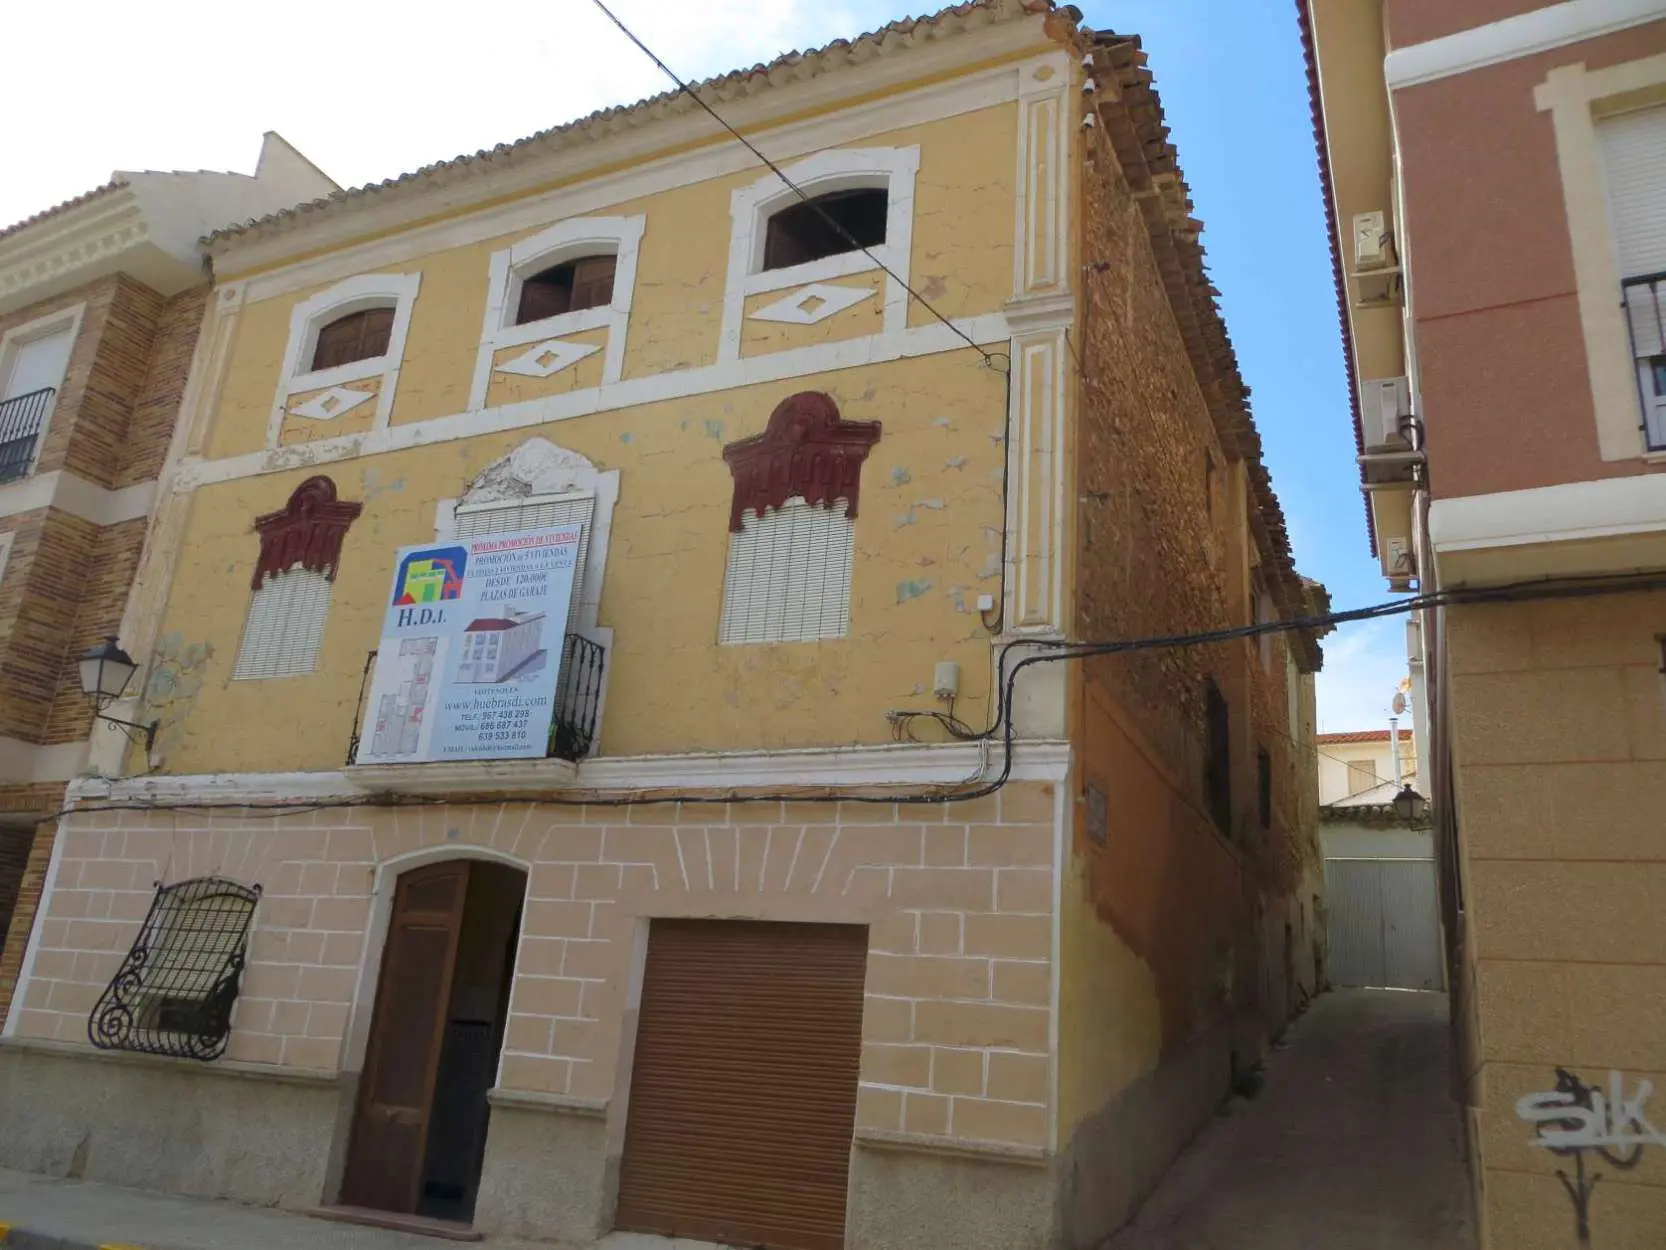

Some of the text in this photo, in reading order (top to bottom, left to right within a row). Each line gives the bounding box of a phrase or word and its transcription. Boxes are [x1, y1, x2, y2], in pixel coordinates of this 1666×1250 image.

[485, 576, 509, 588] DESDE
[480, 588, 506, 601] PLAZAS
[518, 584, 548, 598] GARAJE
